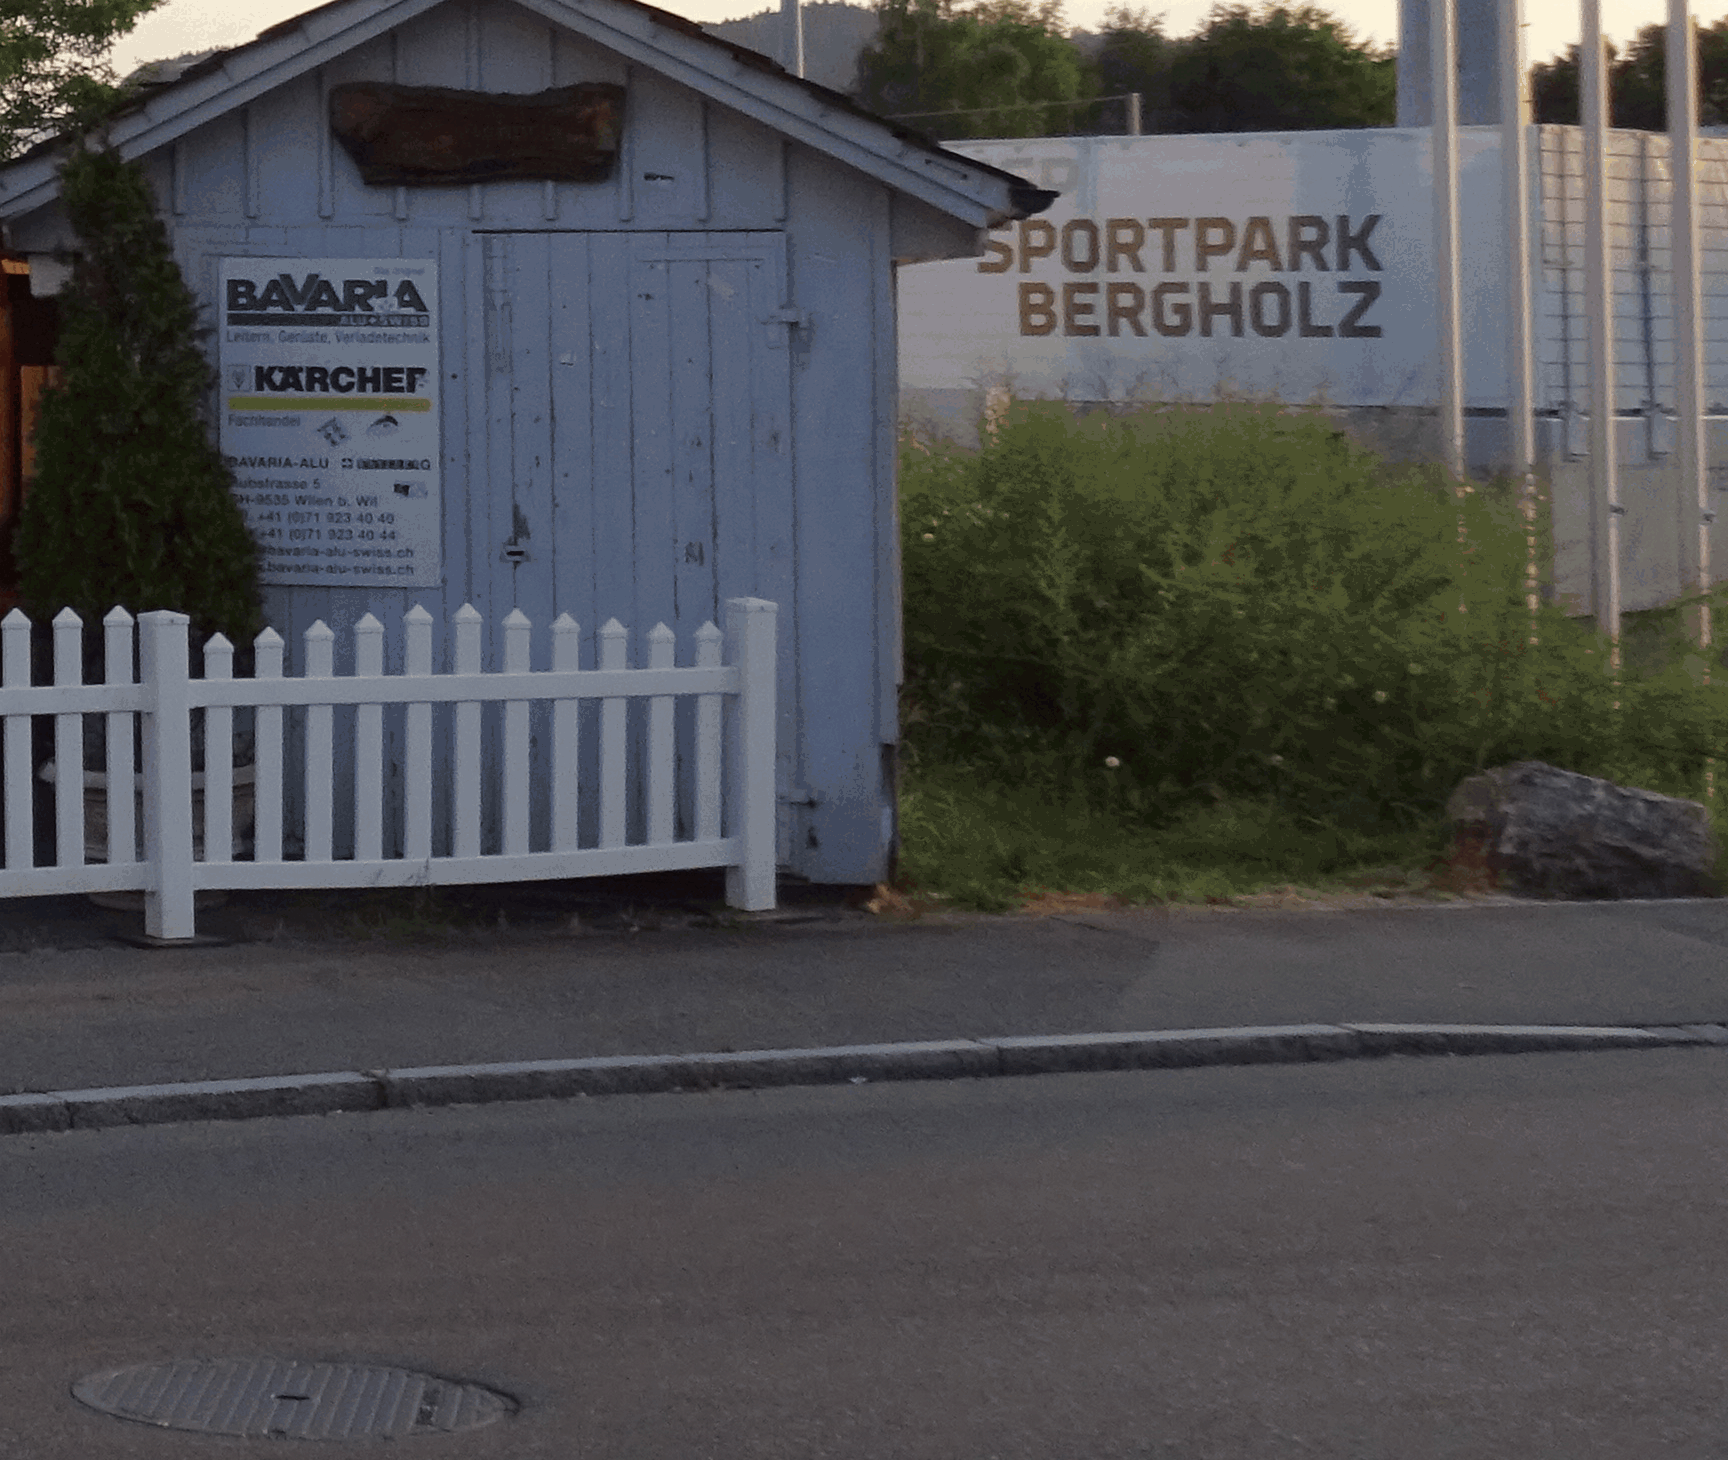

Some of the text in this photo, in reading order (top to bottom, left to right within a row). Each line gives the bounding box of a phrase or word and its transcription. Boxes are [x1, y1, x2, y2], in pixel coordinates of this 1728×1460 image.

[977, 214, 1384, 273] SPORTPARK
[227, 273, 429, 312] BAVARIA
[1017, 280, 1383, 338] BERGHOLZ
[255, 365, 429, 393] KÄRCHER
[357, 512, 374, 524] 40
[377, 512, 395, 525] 40
[357, 528, 375, 541] 40
